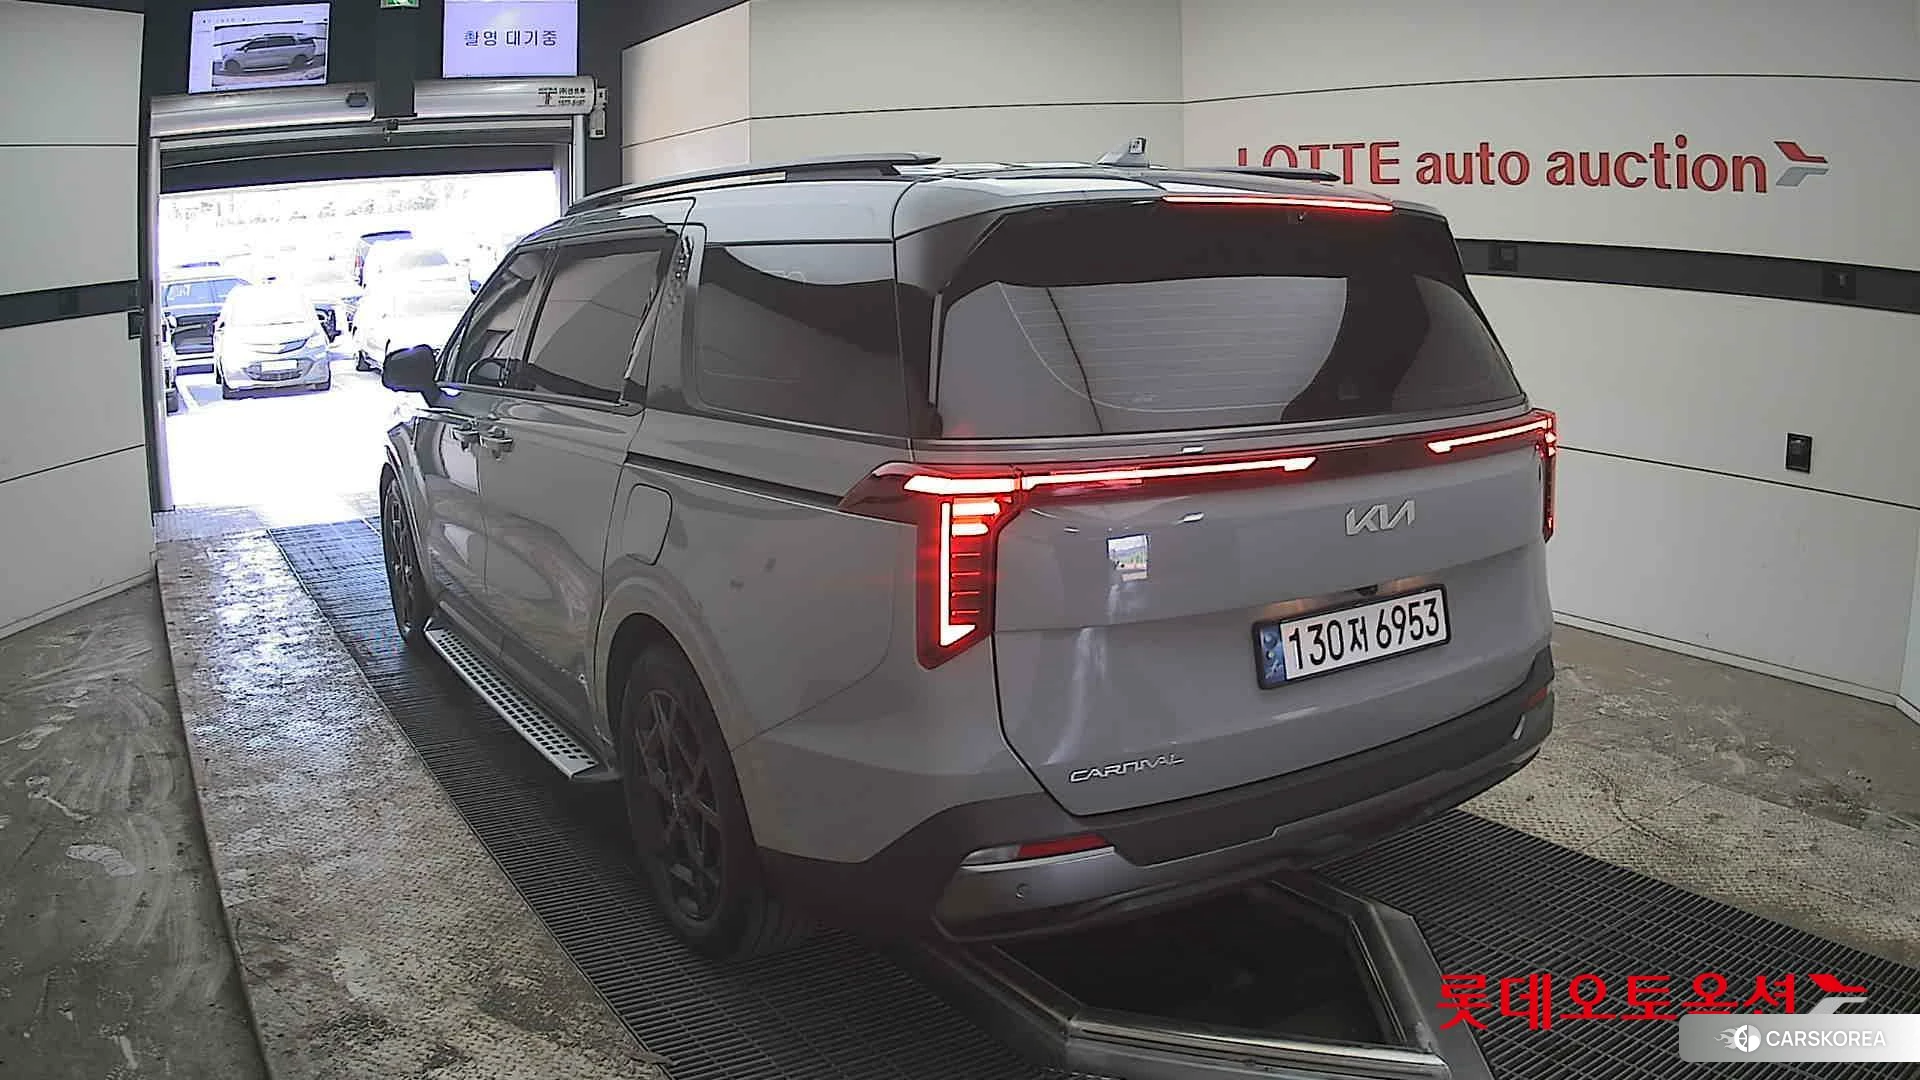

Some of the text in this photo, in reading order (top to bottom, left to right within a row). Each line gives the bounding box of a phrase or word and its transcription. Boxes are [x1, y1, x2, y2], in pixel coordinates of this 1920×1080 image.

[506, 30, 557, 46] 대기중
[1416, 143, 1530, 186] auto
[1546, 135, 1768, 193] auction
[1345, 499, 1415, 536] KIA
[1288, 598, 1440, 670] 130저 6953
[1069, 753, 1185, 783] CARNIVAL
